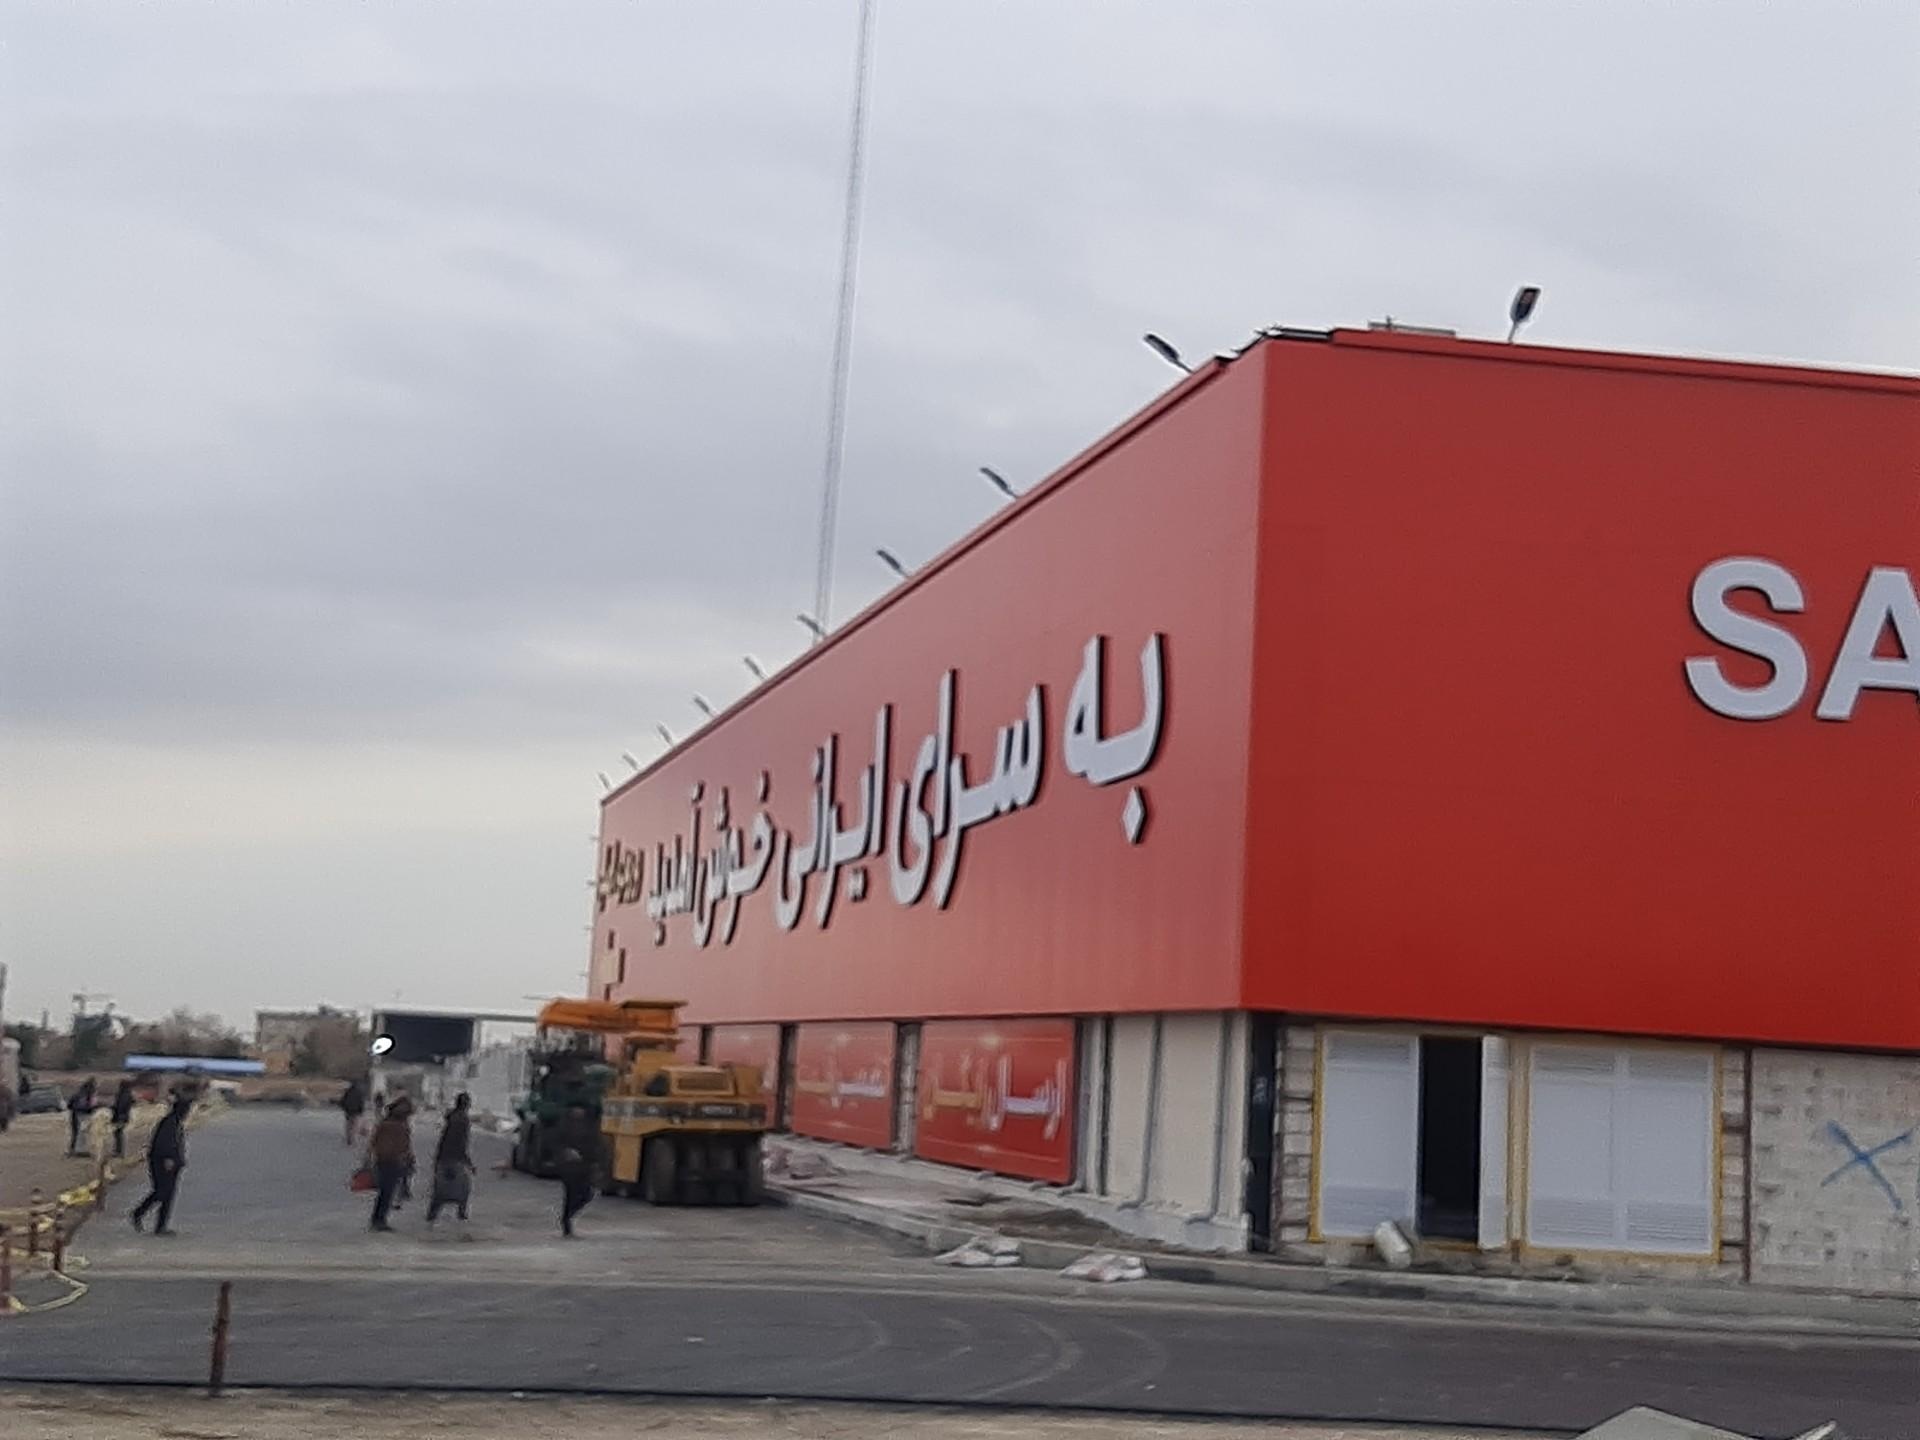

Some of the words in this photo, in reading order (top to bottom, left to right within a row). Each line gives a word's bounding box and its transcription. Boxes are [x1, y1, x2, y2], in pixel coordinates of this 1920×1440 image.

[774, 703, 892, 930] ایرانی
[889, 668, 1047, 910] سرای
[1063, 632, 1167, 844] به
[647, 780, 705, 947] آمدید
[693, 770, 778, 948] خوش
